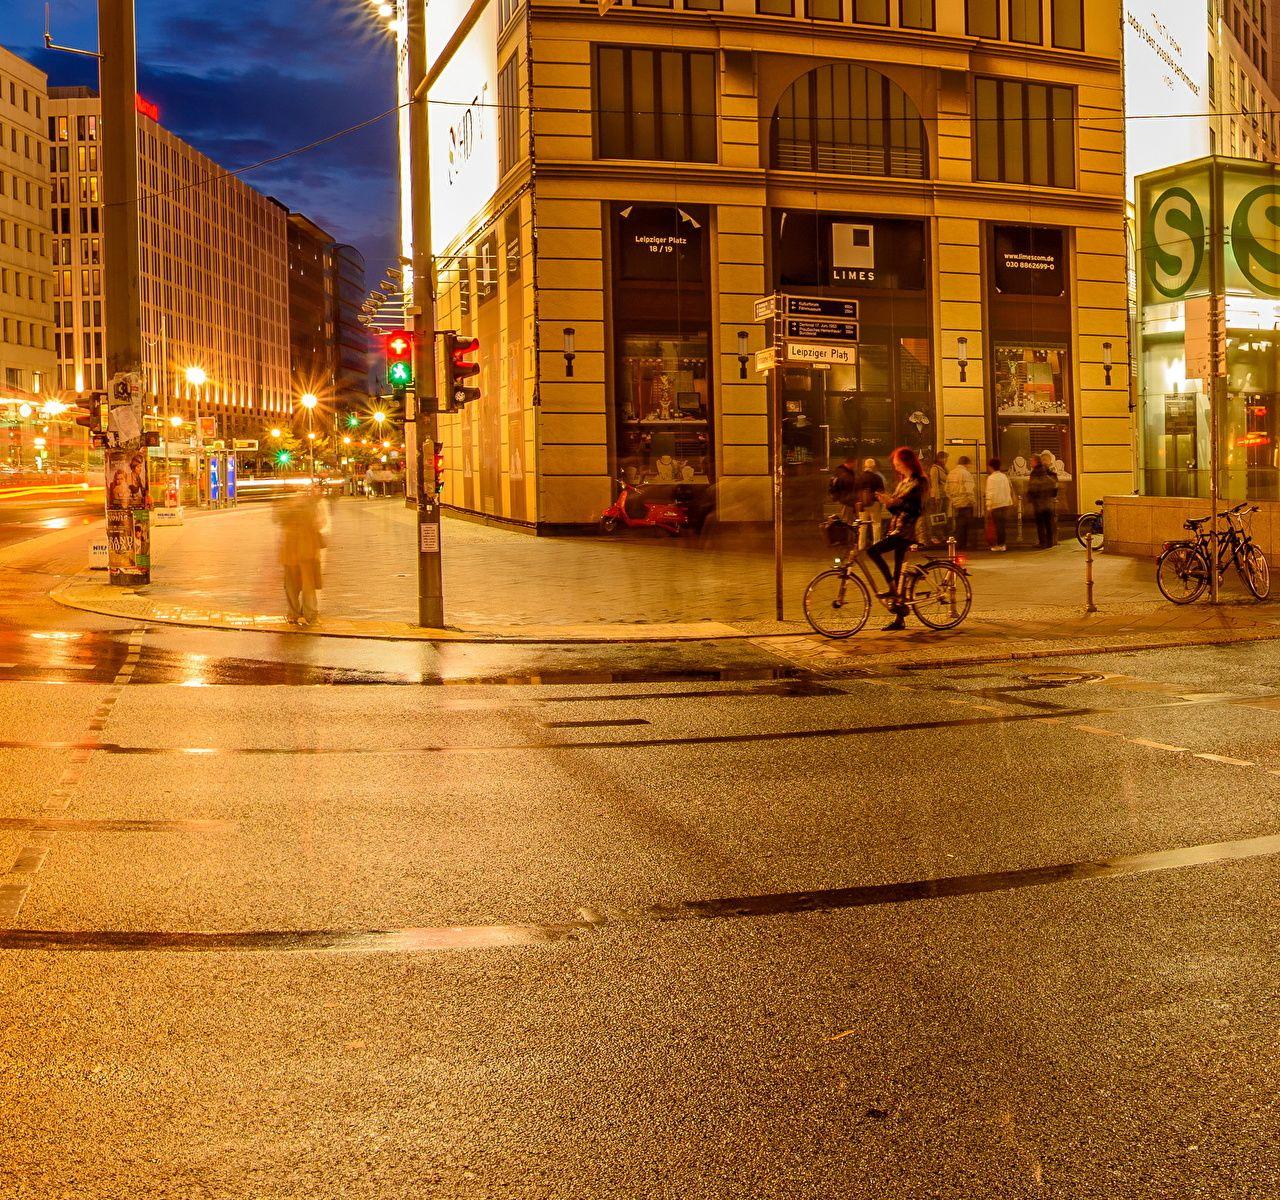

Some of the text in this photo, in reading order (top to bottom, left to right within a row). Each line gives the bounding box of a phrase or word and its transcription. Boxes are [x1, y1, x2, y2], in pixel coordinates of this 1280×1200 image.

[635, 235, 687, 245] Leipziger Platz
[1003, 253, 1055, 262] www.limescom.de
[1019, 261, 1055, 271] 8862699-0
[833, 270, 875, 281] LIMES
[792, 346, 849, 362] Leipziger Platz
